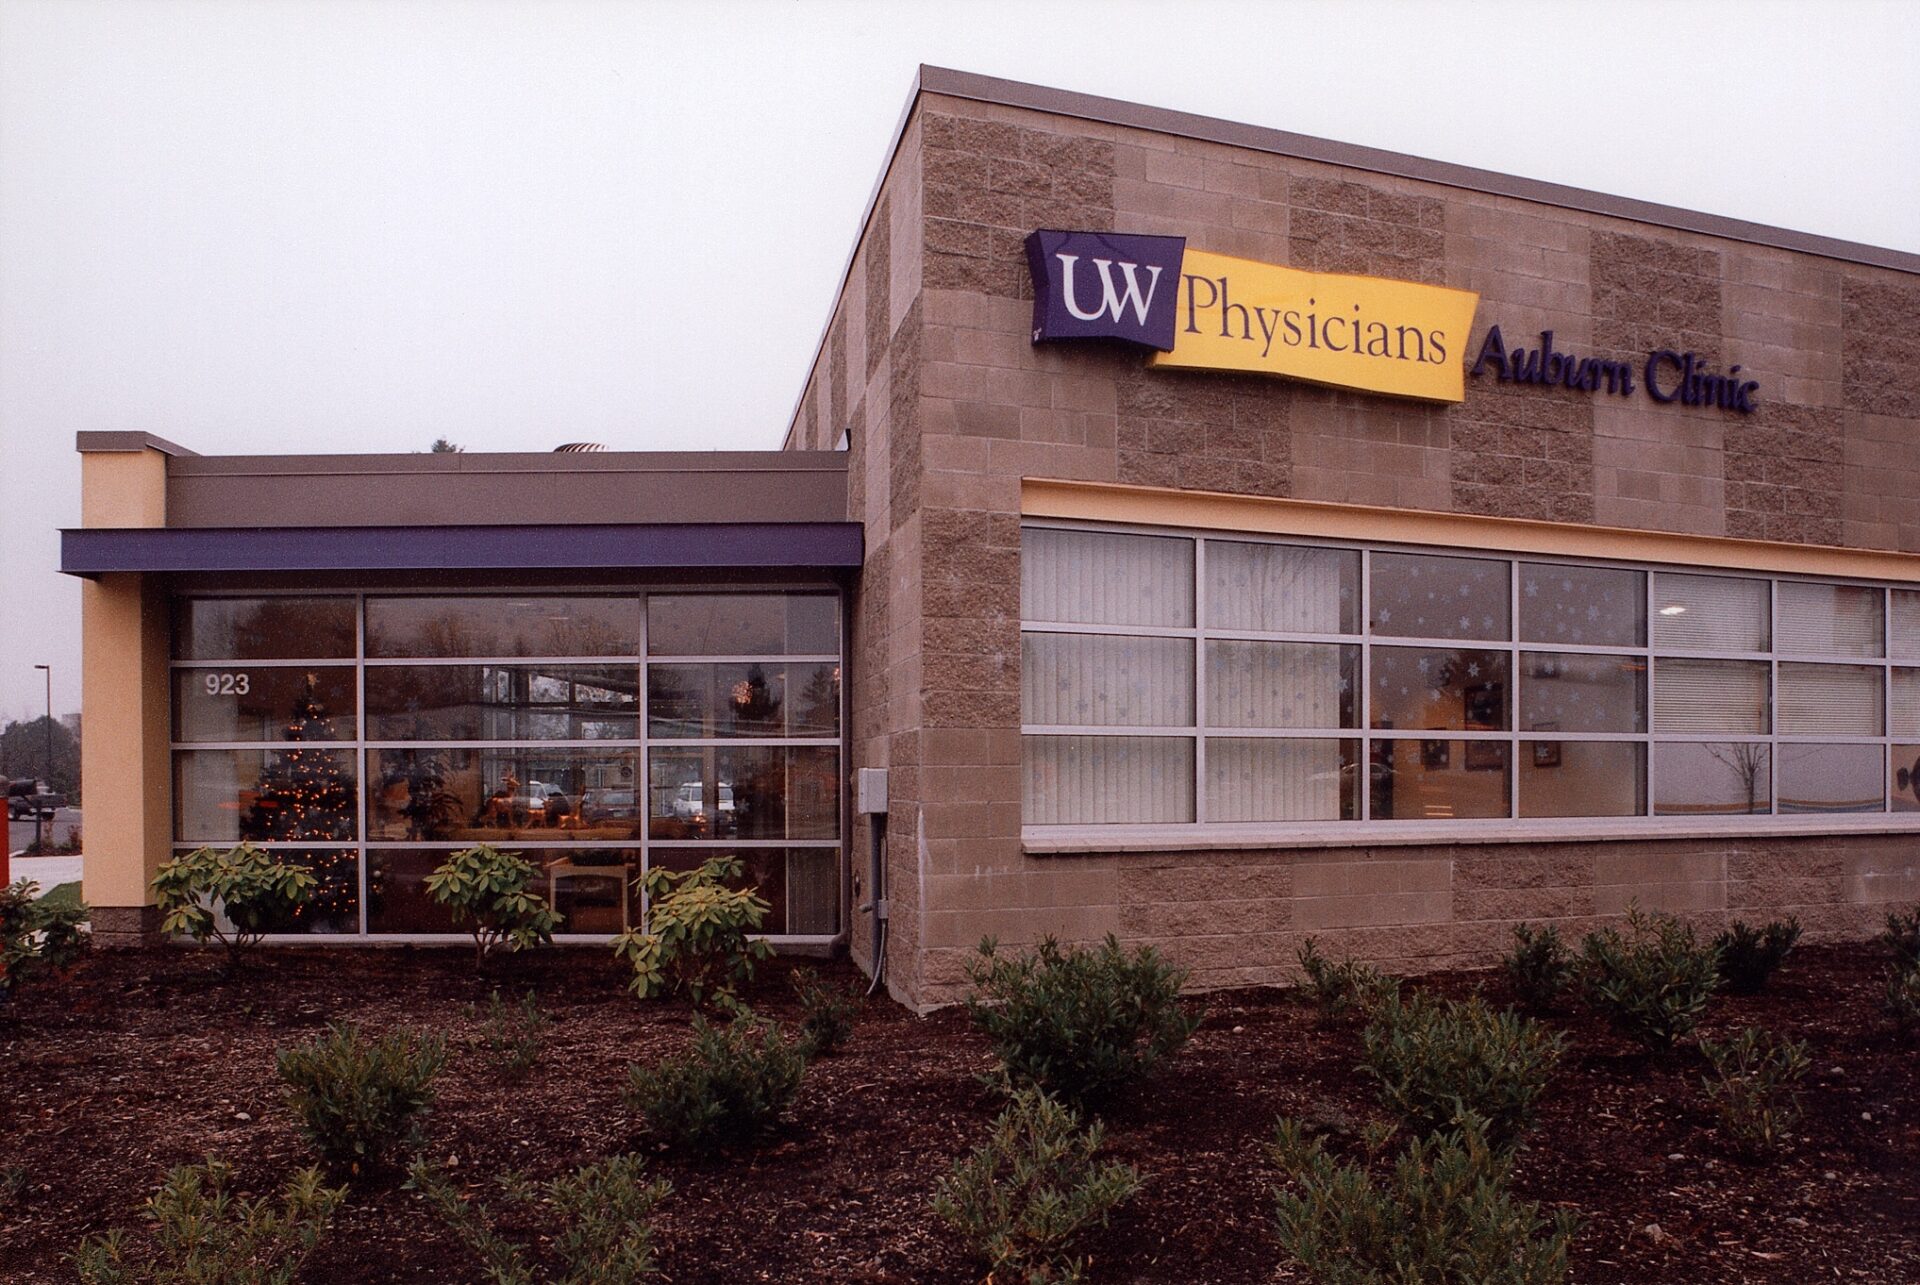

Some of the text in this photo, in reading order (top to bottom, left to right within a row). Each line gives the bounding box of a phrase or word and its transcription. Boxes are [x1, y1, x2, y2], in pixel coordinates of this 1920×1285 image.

[1056, 253, 1447, 366] UW Physicians
[1470, 324, 1760, 413] Auburn Clinic
[205, 673, 250, 695] 923
